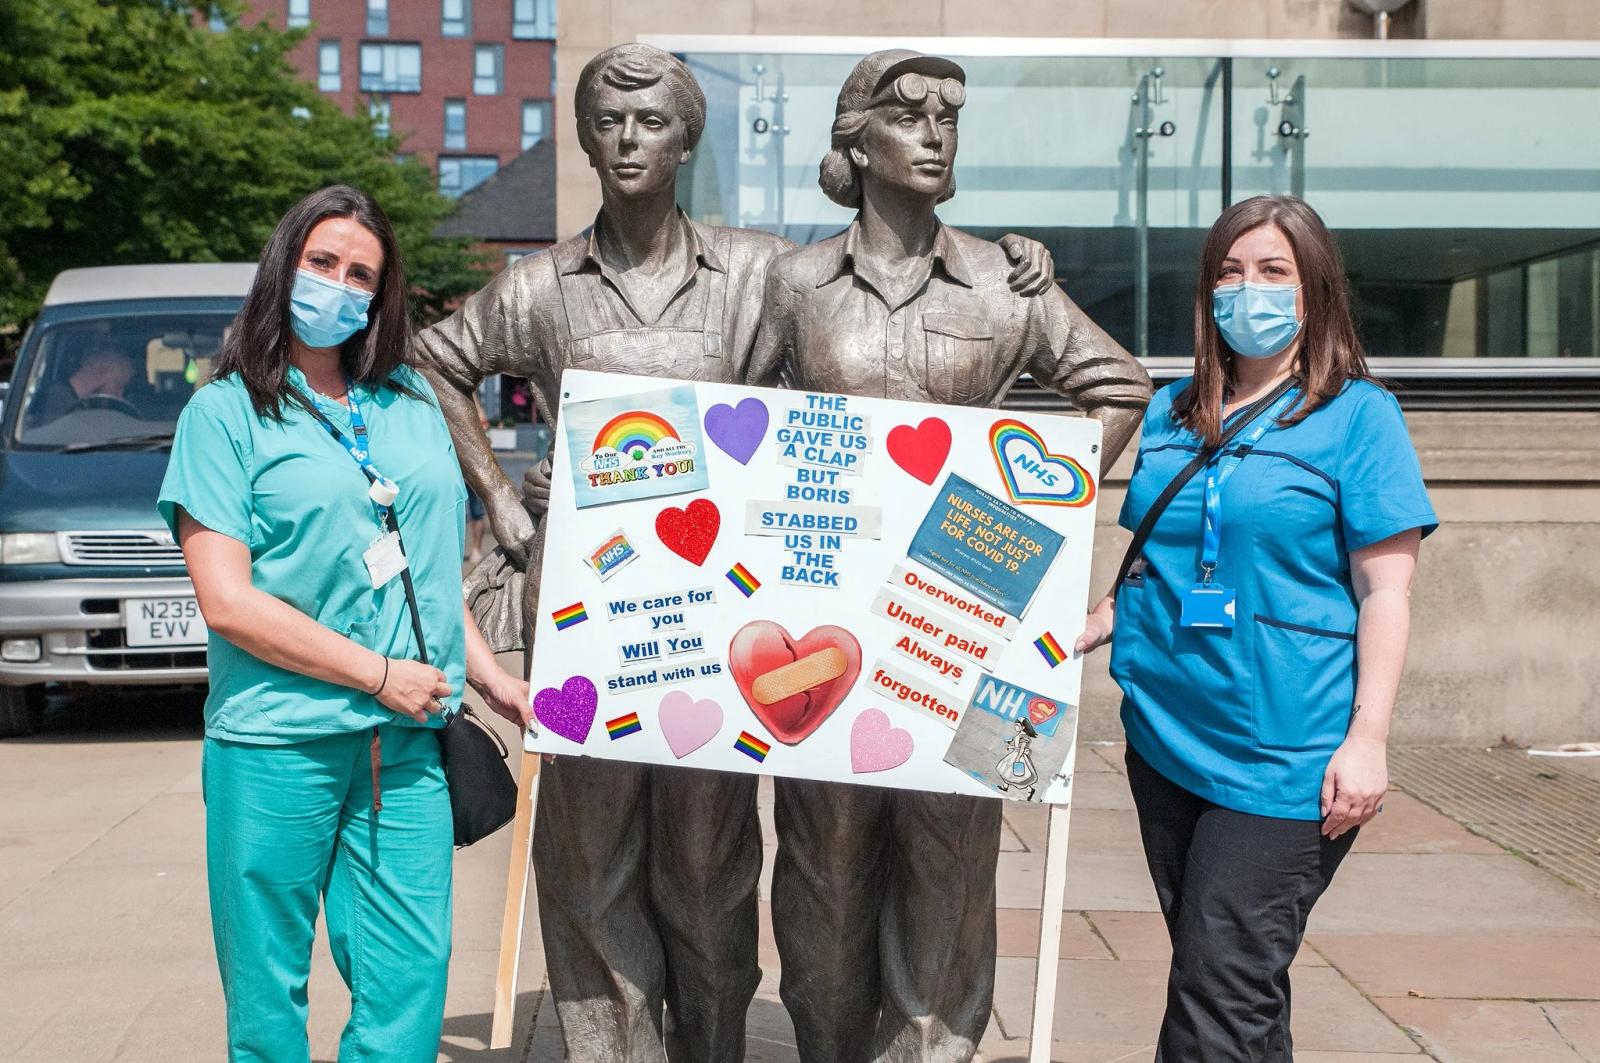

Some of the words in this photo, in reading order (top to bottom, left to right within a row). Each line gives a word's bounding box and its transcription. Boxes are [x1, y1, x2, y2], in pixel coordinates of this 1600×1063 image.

[806, 395, 847, 411] THE
[788, 410, 863, 431] PUBLIC
[777, 429, 832, 447] GAVE
[840, 434, 867, 450] US
[594, 457, 619, 470] NHS
[783, 443, 797, 458] A
[804, 447, 857, 467] CLAP
[588, 466, 649, 487] THANK
[652, 459, 694, 477] YOU!
[797, 468, 840, 485] BUT
[1013, 453, 1059, 487] NHS
[787, 485, 850, 504] BORIS
[762, 511, 858, 531] STABBED
[947, 493, 994, 526] NURSES
[994, 522, 1018, 541] ARE
[1018, 536, 1043, 557] FOR
[785, 534, 812, 549] US
[820, 535, 841, 550] IN
[946, 509, 972, 532] LIFE,
[975, 526, 1002, 546] NOT
[1001, 542, 1031, 563] JUST
[600, 543, 625, 566] NHS
[941, 520, 965, 542] FOR
[966, 536, 1004, 563] COVID
[1005, 560, 1020, 575] 19.
[793, 551, 834, 569] THE
[781, 565, 839, 586] BACK
[142, 601, 197, 619] N235
[609, 600, 637, 615] We
[643, 595, 683, 610] care
[687, 590, 713, 603] for
[904, 572, 1006, 628] Overworked
[151, 621, 190, 638] EVV
[651, 613, 684, 629] you
[887, 601, 944, 638] Under
[944, 633, 989, 660] paid
[621, 640, 660, 659] Will
[666, 637, 702, 651] You
[896, 636, 964, 678] Always
[607, 670, 658, 689] stand
[662, 667, 695, 681] with
[700, 663, 722, 676] us
[873, 669, 959, 722] forgotten
